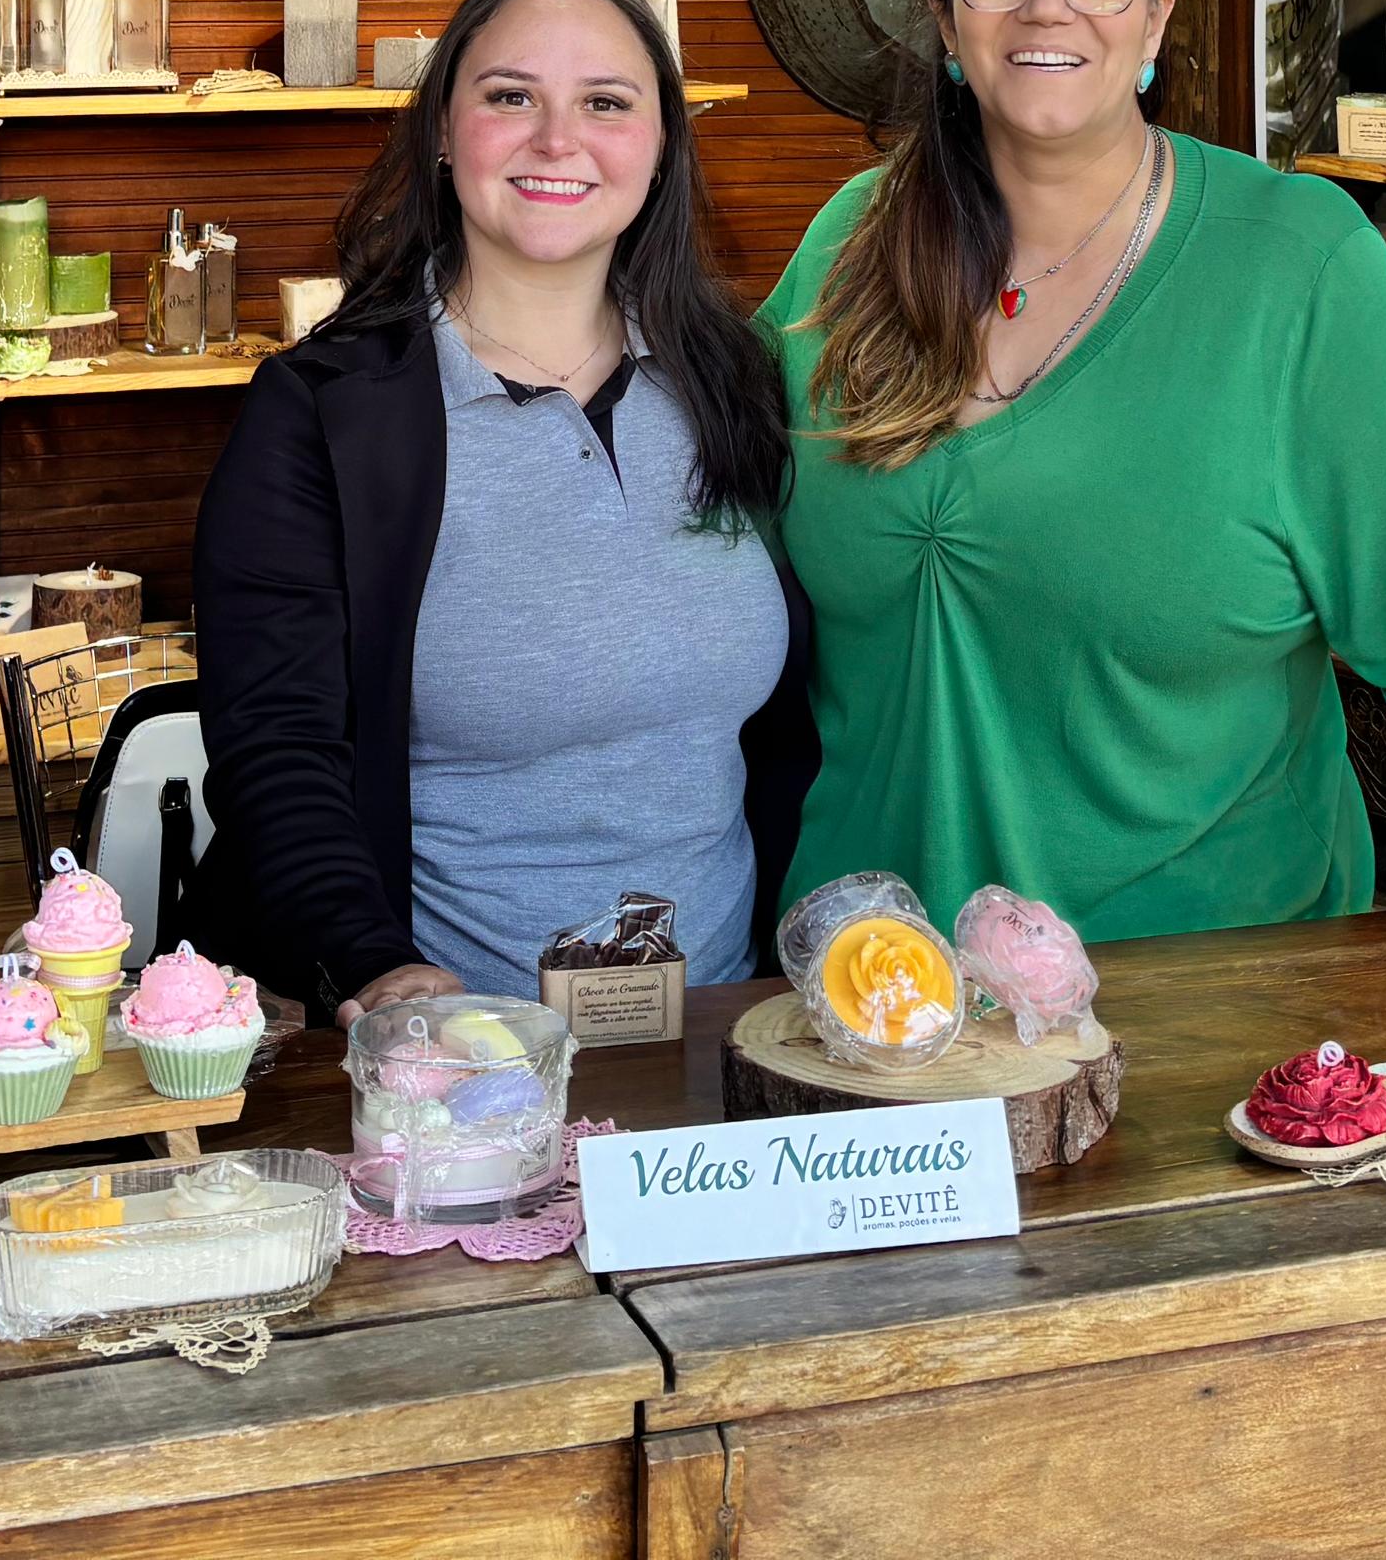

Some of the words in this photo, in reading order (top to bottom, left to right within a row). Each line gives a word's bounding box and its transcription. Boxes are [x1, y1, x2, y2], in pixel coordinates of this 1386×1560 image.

[578, 986, 605, 997] Choco
[607, 985, 618, 995] de
[620, 979, 660, 994] Gramado
[629, 1141, 756, 1198] Velas
[767, 1128, 973, 1186] Naturais
[859, 1184, 959, 1219] DEVITÊ
